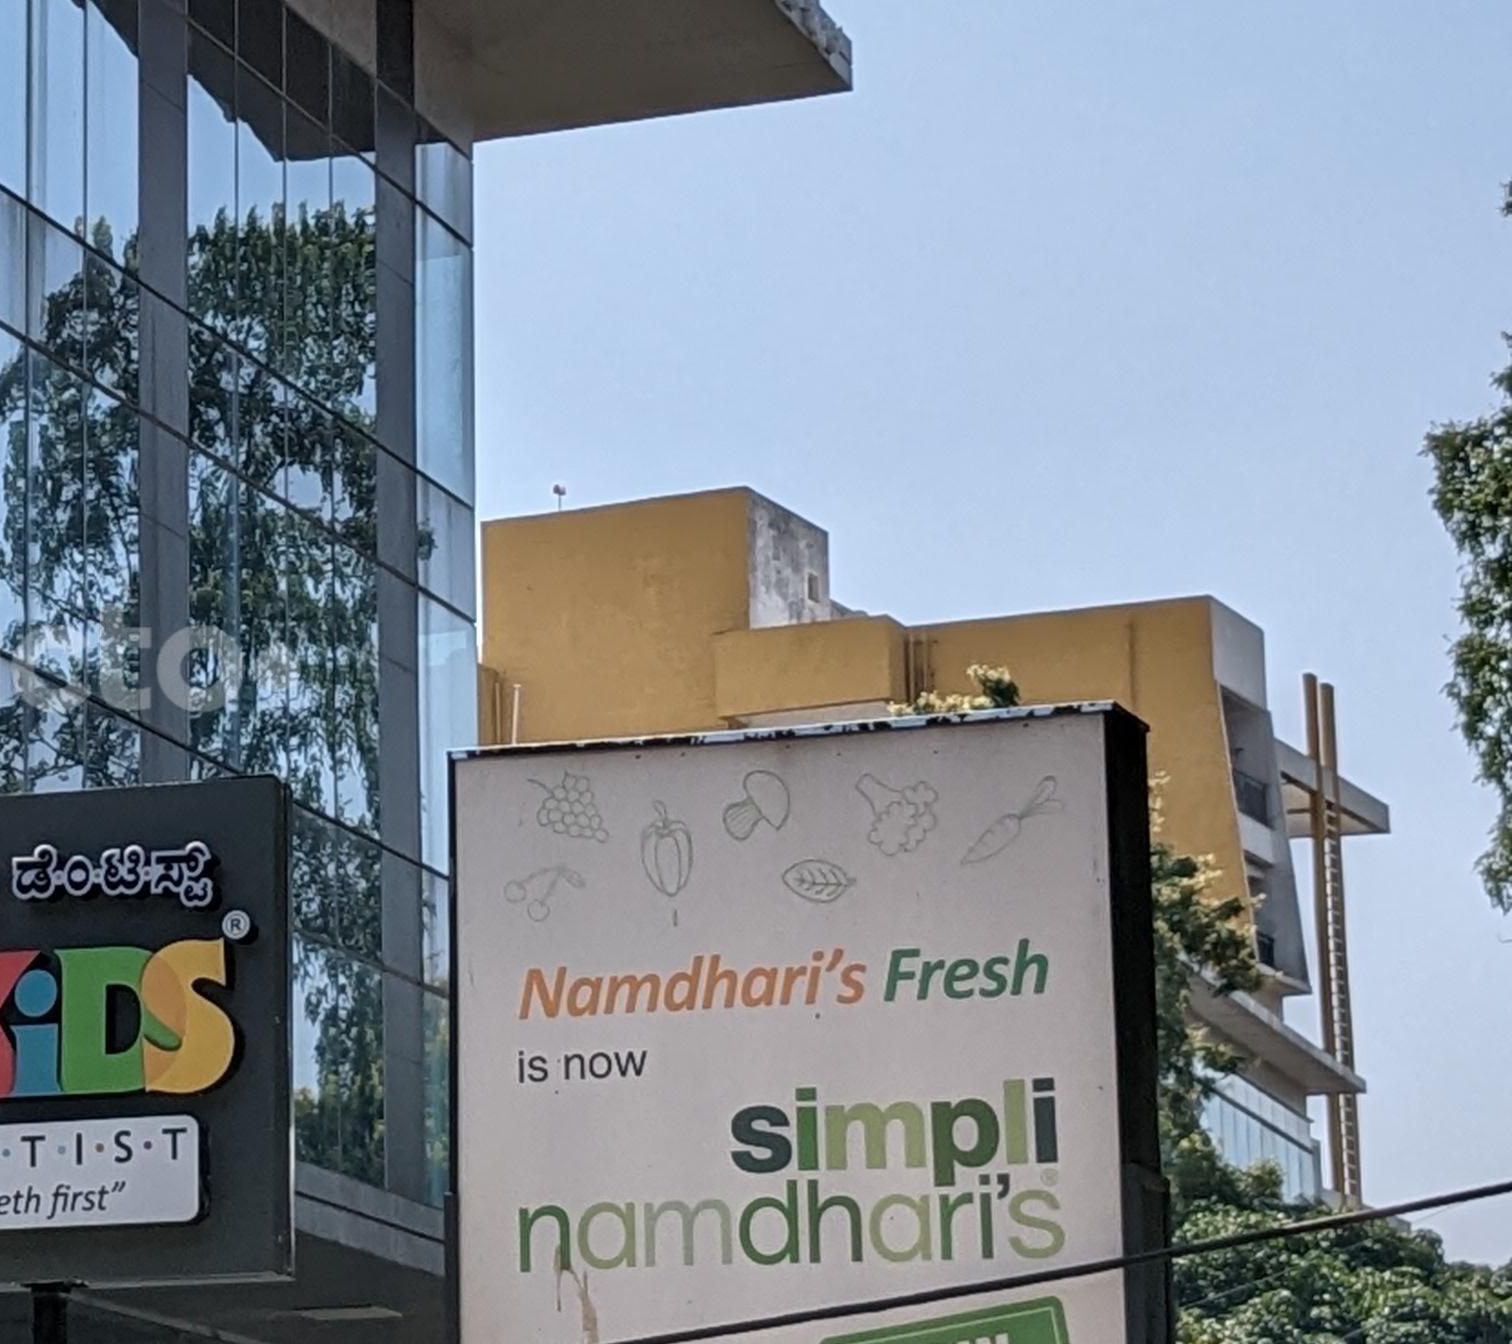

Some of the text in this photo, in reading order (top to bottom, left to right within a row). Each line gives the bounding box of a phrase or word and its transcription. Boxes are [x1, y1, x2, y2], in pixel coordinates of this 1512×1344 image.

[882, 938, 1050, 1003] Fresh
[518, 1050, 648, 1084] is now
[730, 1076, 1058, 1188] simpli
